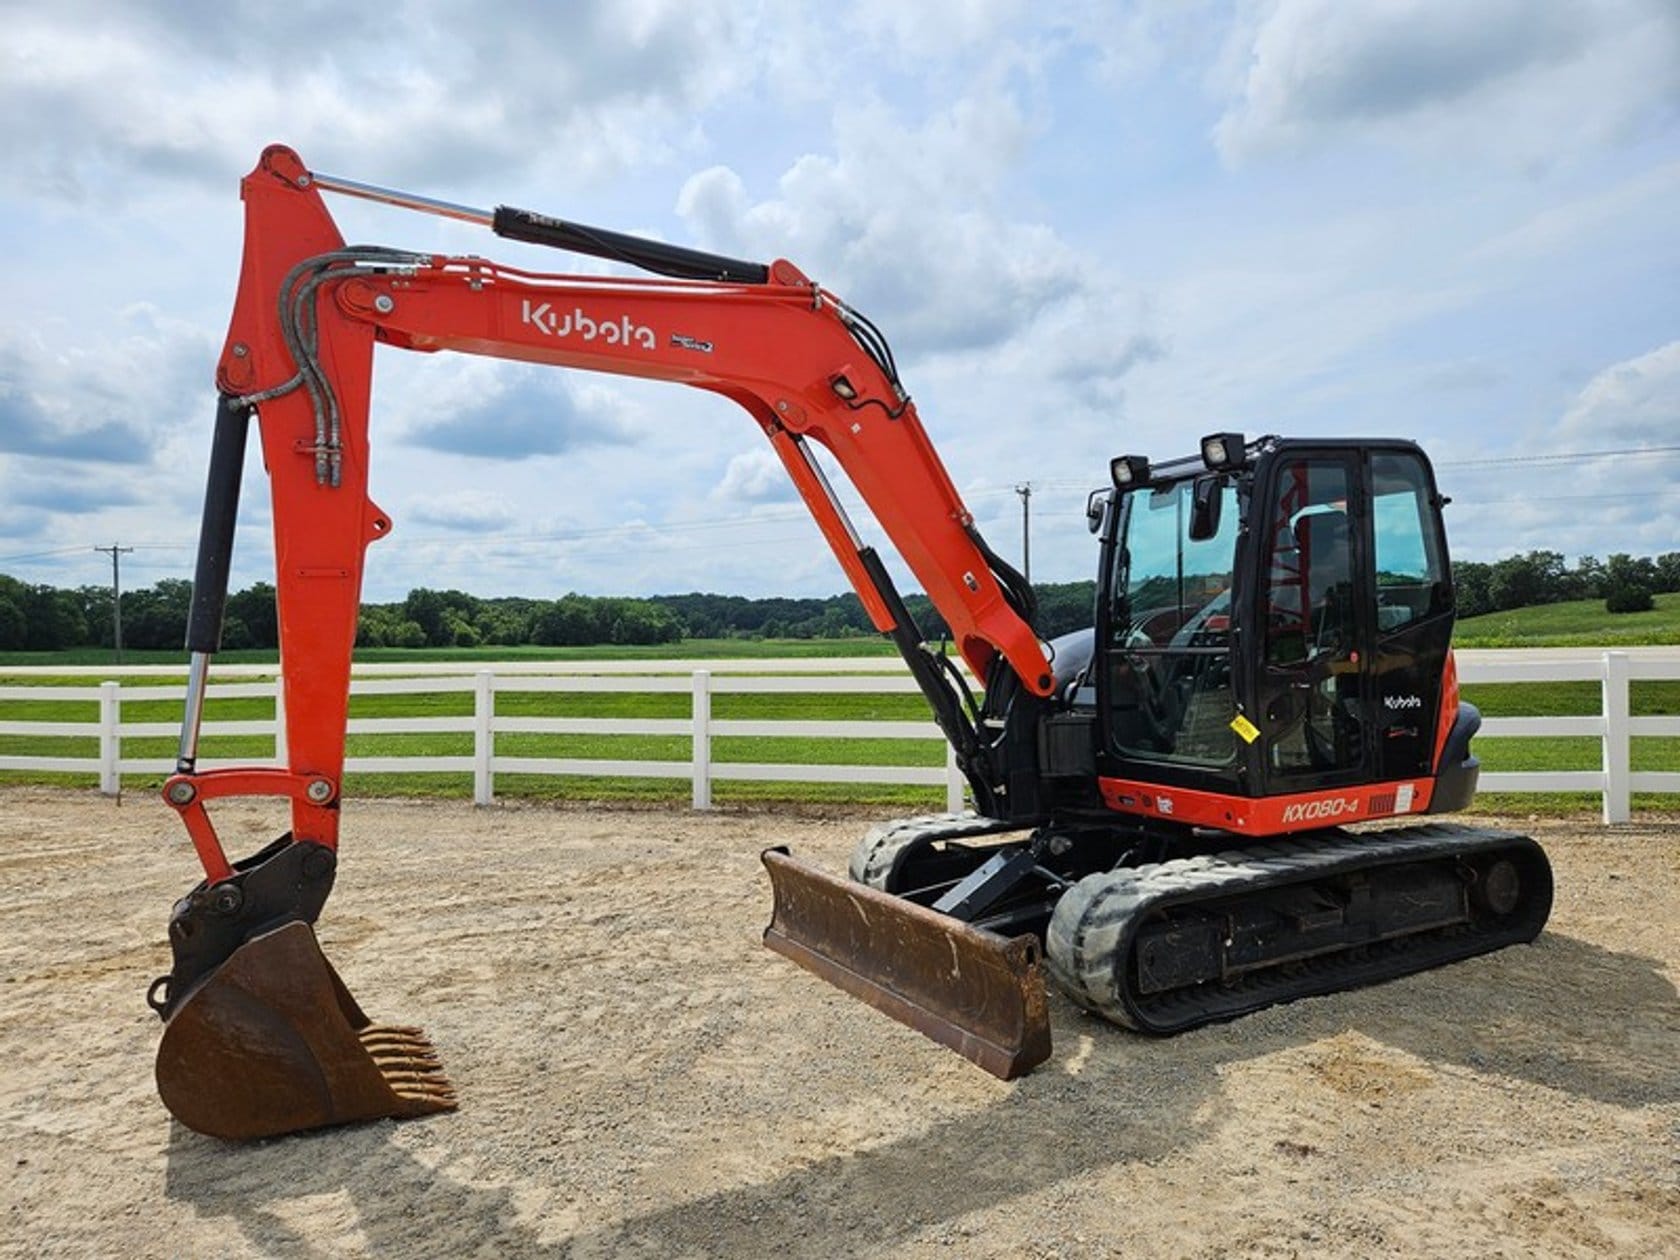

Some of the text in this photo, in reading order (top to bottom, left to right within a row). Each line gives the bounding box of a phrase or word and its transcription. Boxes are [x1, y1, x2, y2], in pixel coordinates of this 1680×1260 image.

[522, 300, 655, 349] Kubota
[1383, 695, 1421, 709] Kubota
[1282, 798, 1359, 823] KX080-4
